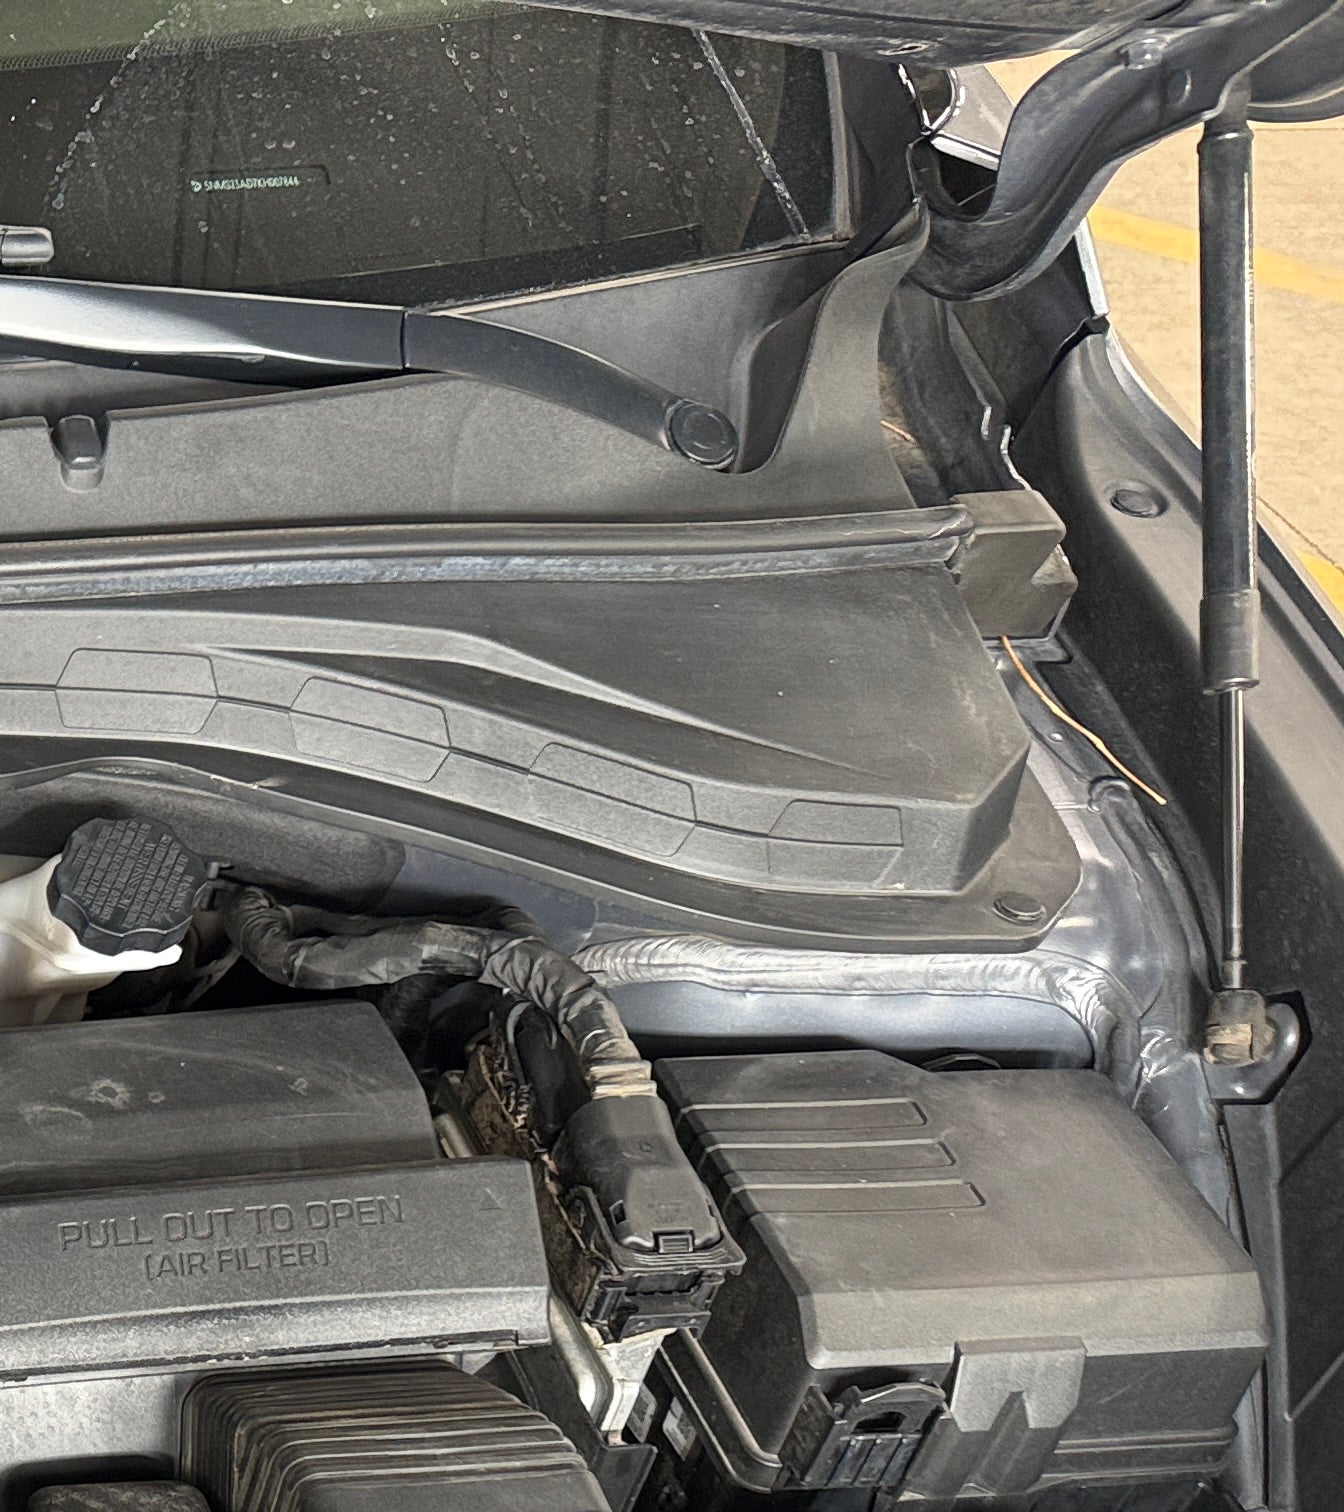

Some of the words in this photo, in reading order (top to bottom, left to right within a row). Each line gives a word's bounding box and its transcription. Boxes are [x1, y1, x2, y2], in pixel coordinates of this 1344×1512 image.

[57, 1216, 153, 1250] PULL
[162, 1207, 236, 1242] OUT
[244, 1203, 295, 1235] TO
[305, 1195, 404, 1230] OPEN
